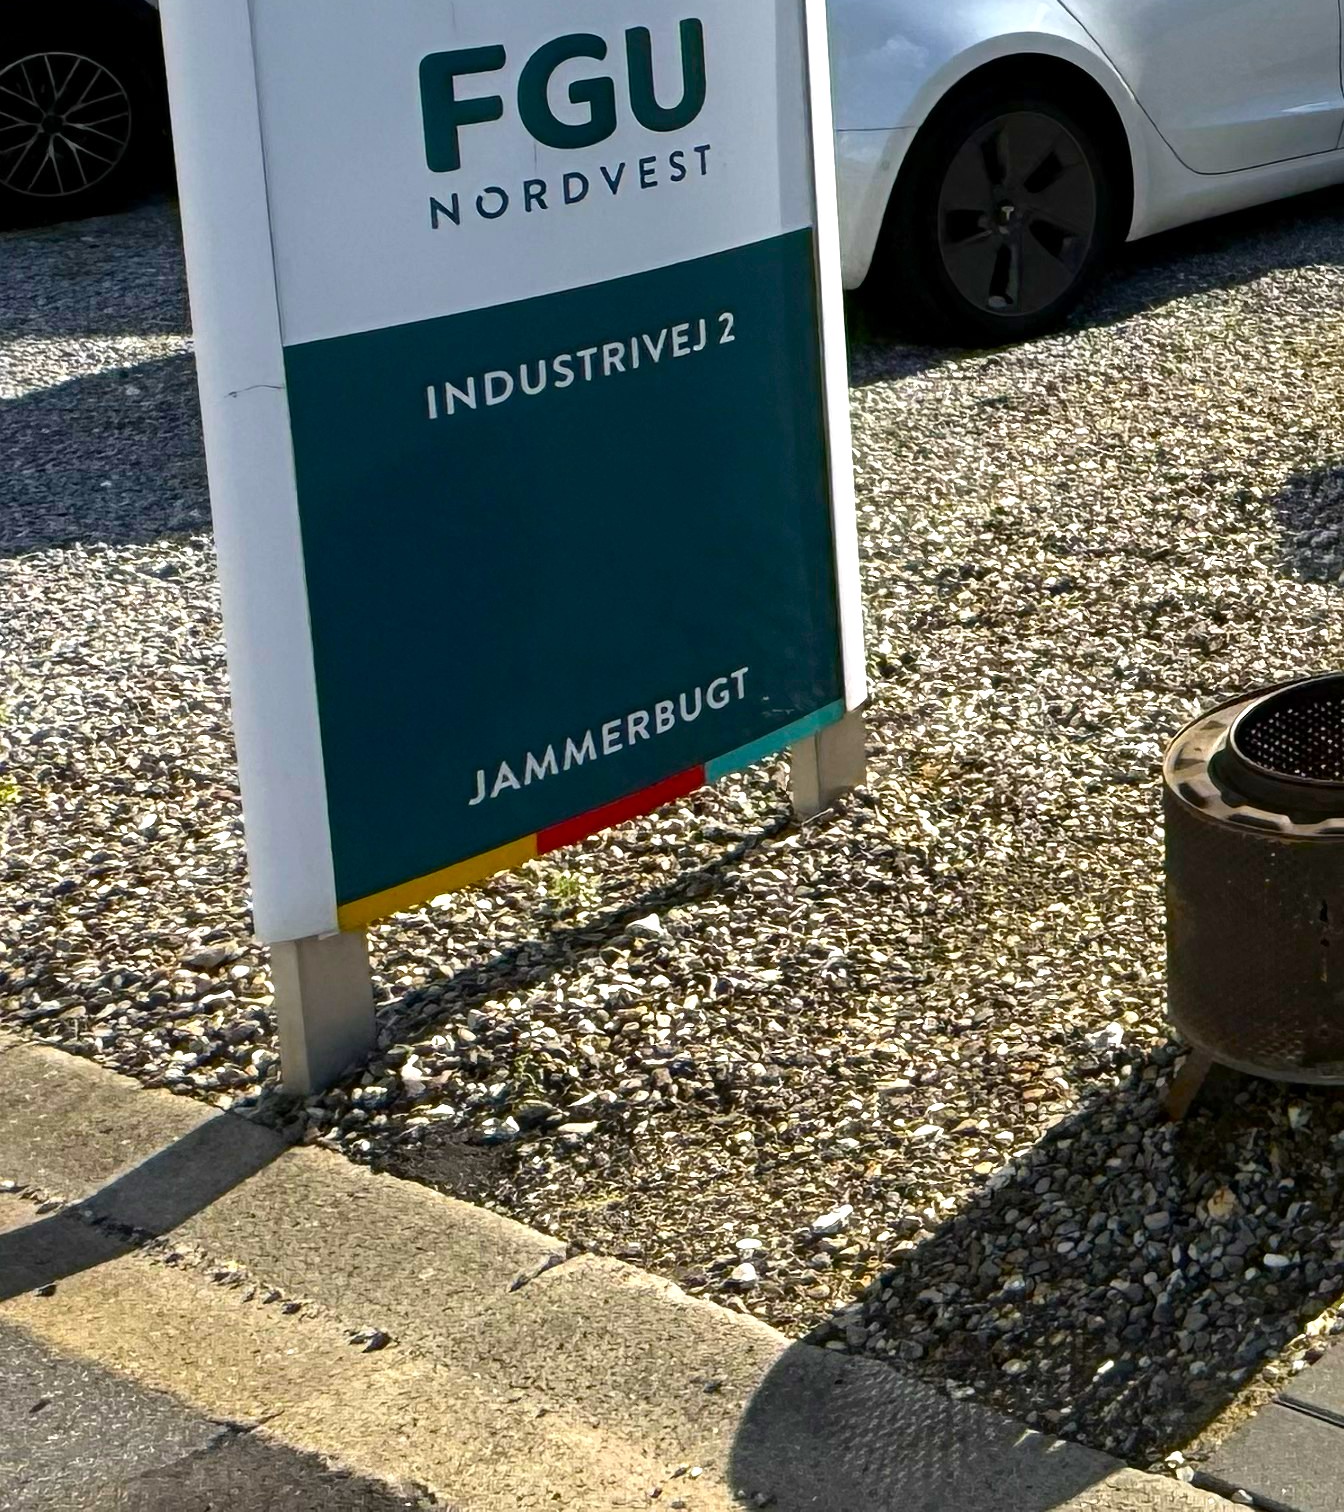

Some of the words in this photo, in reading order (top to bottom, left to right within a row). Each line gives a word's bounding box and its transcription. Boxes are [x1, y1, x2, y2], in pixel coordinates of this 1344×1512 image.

[418, 17, 707, 174] FGU
[429, 143, 711, 230] NORDVEST
[426, 318, 707, 420] INDUSTRIVEJ
[717, 311, 736, 345] 2
[467, 666, 750, 807] JAMMERBUGT
